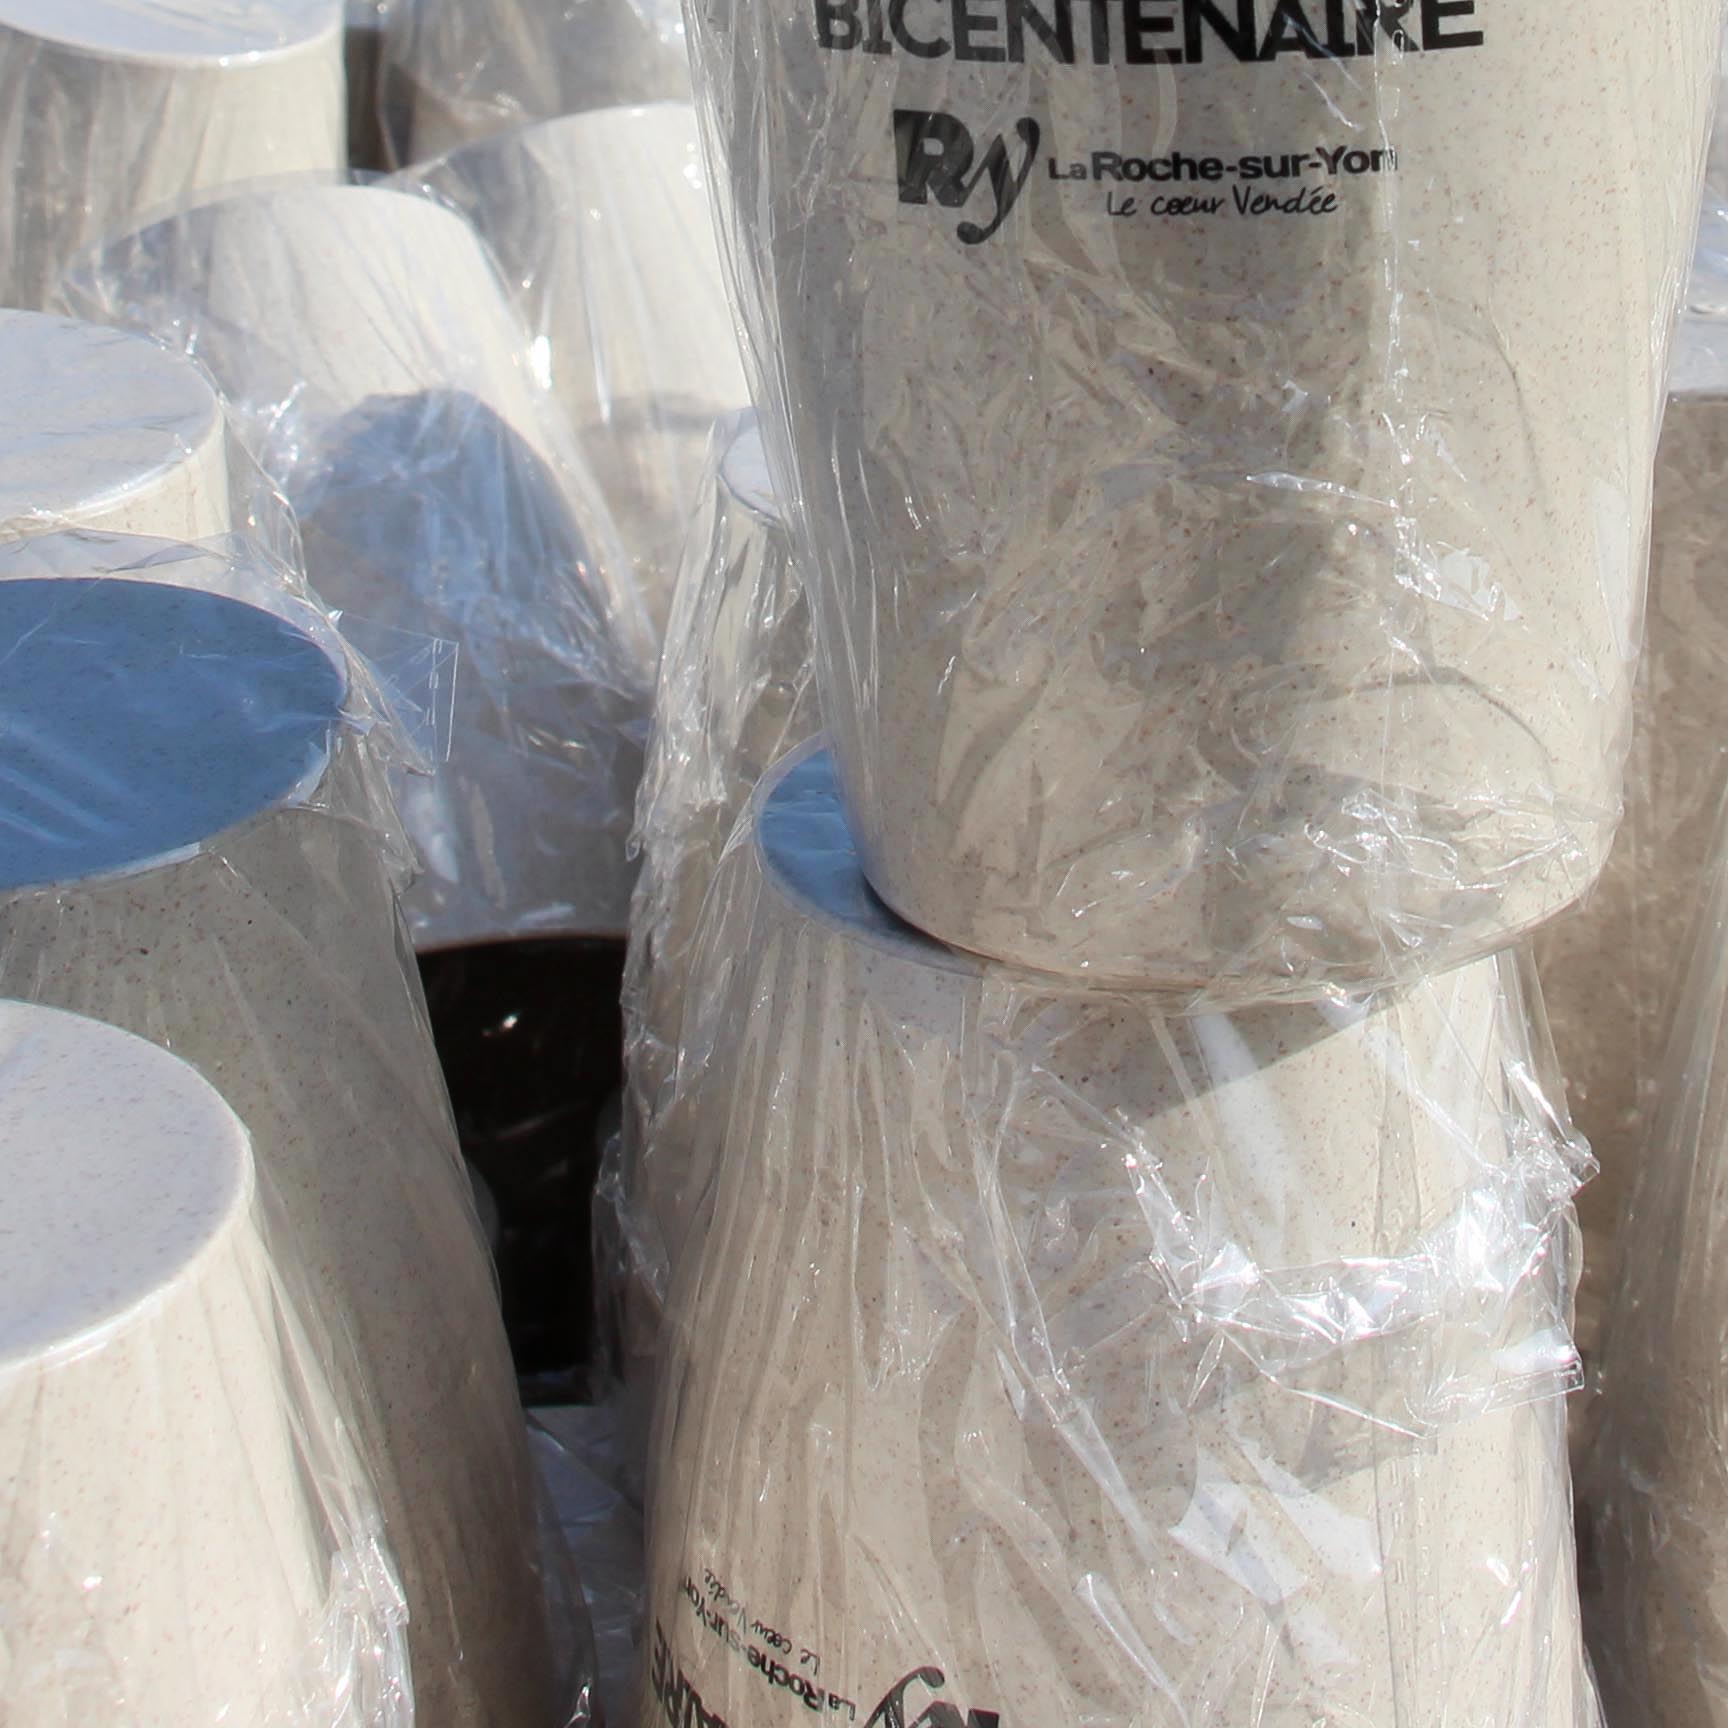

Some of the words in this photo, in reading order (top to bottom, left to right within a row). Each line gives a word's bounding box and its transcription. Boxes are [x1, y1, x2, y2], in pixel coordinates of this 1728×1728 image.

[1089, 145, 1399, 182] Roche-sur-Yon
[1107, 191, 1137, 217] Le
[1231, 184, 1339, 216] Vendée
